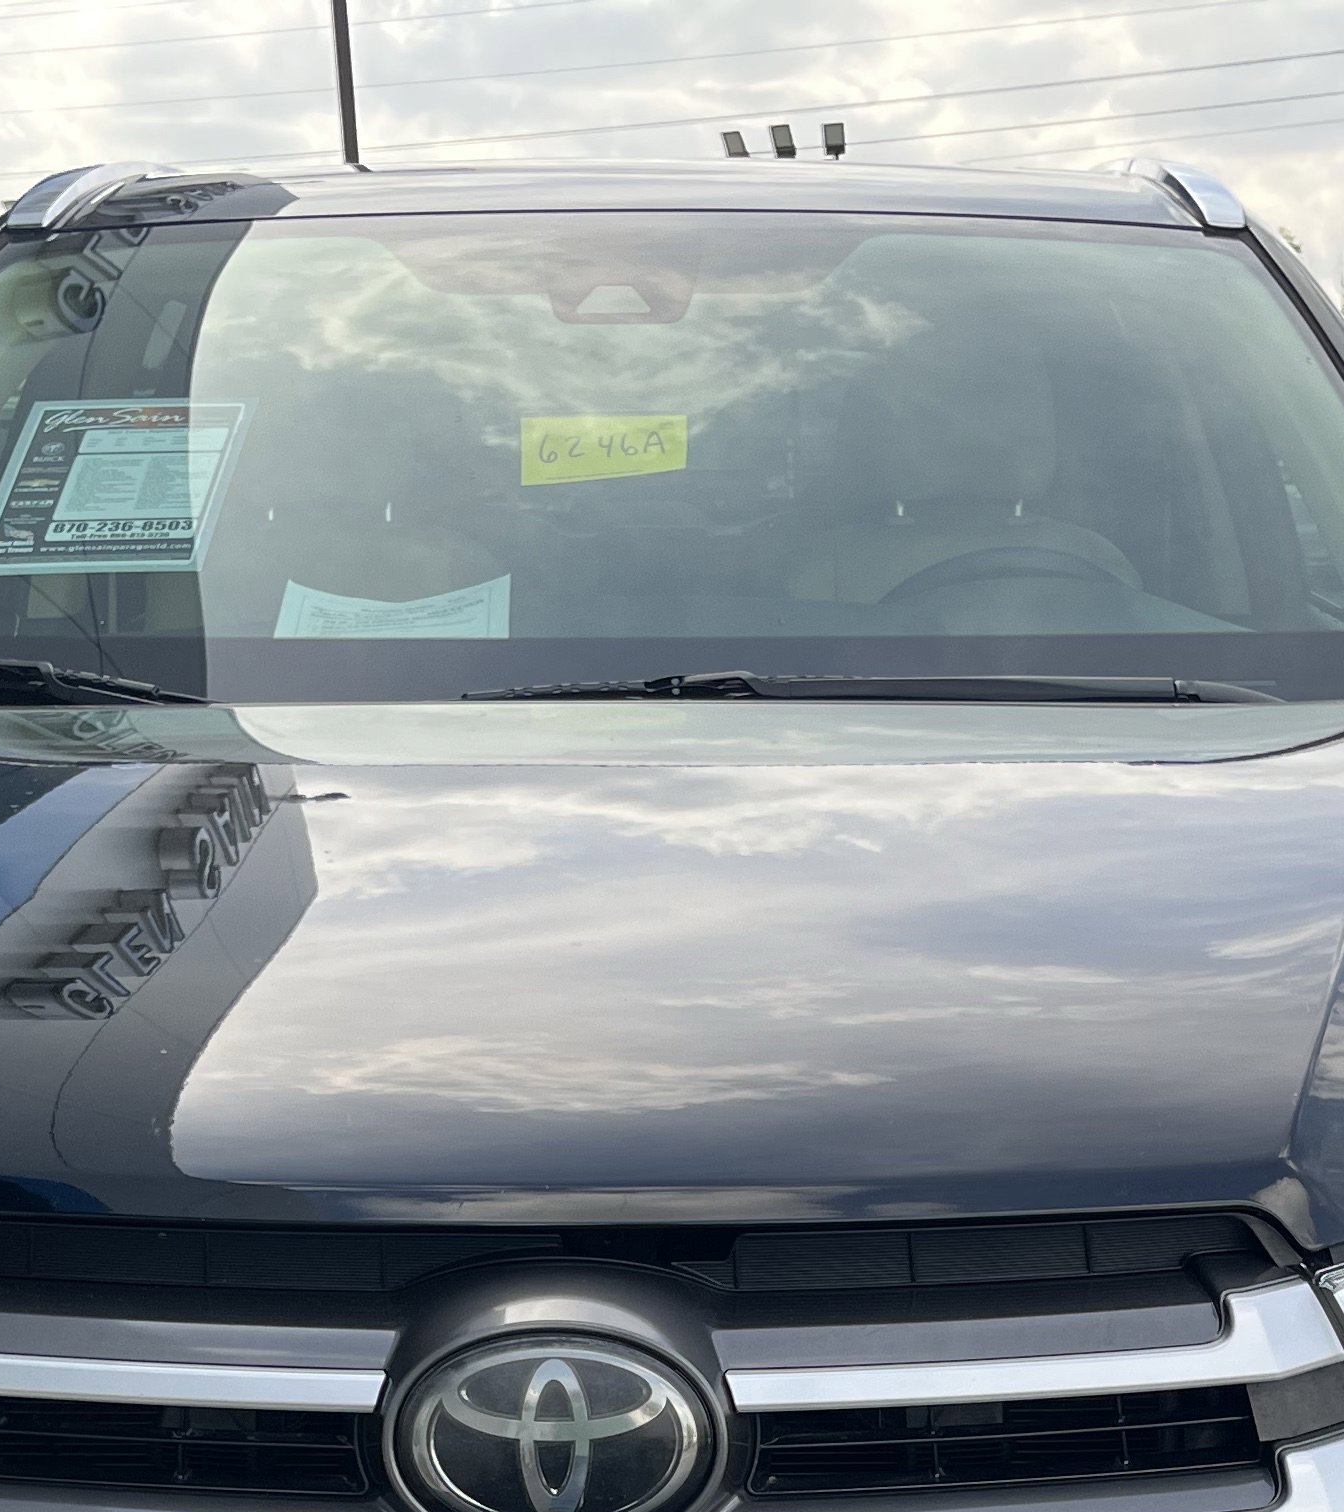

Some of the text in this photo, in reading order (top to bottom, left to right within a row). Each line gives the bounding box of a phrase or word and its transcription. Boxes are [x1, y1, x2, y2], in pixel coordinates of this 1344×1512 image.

[43, 408, 186, 433] Glen Sain
[52, 519, 193, 534] 870-236-8503
